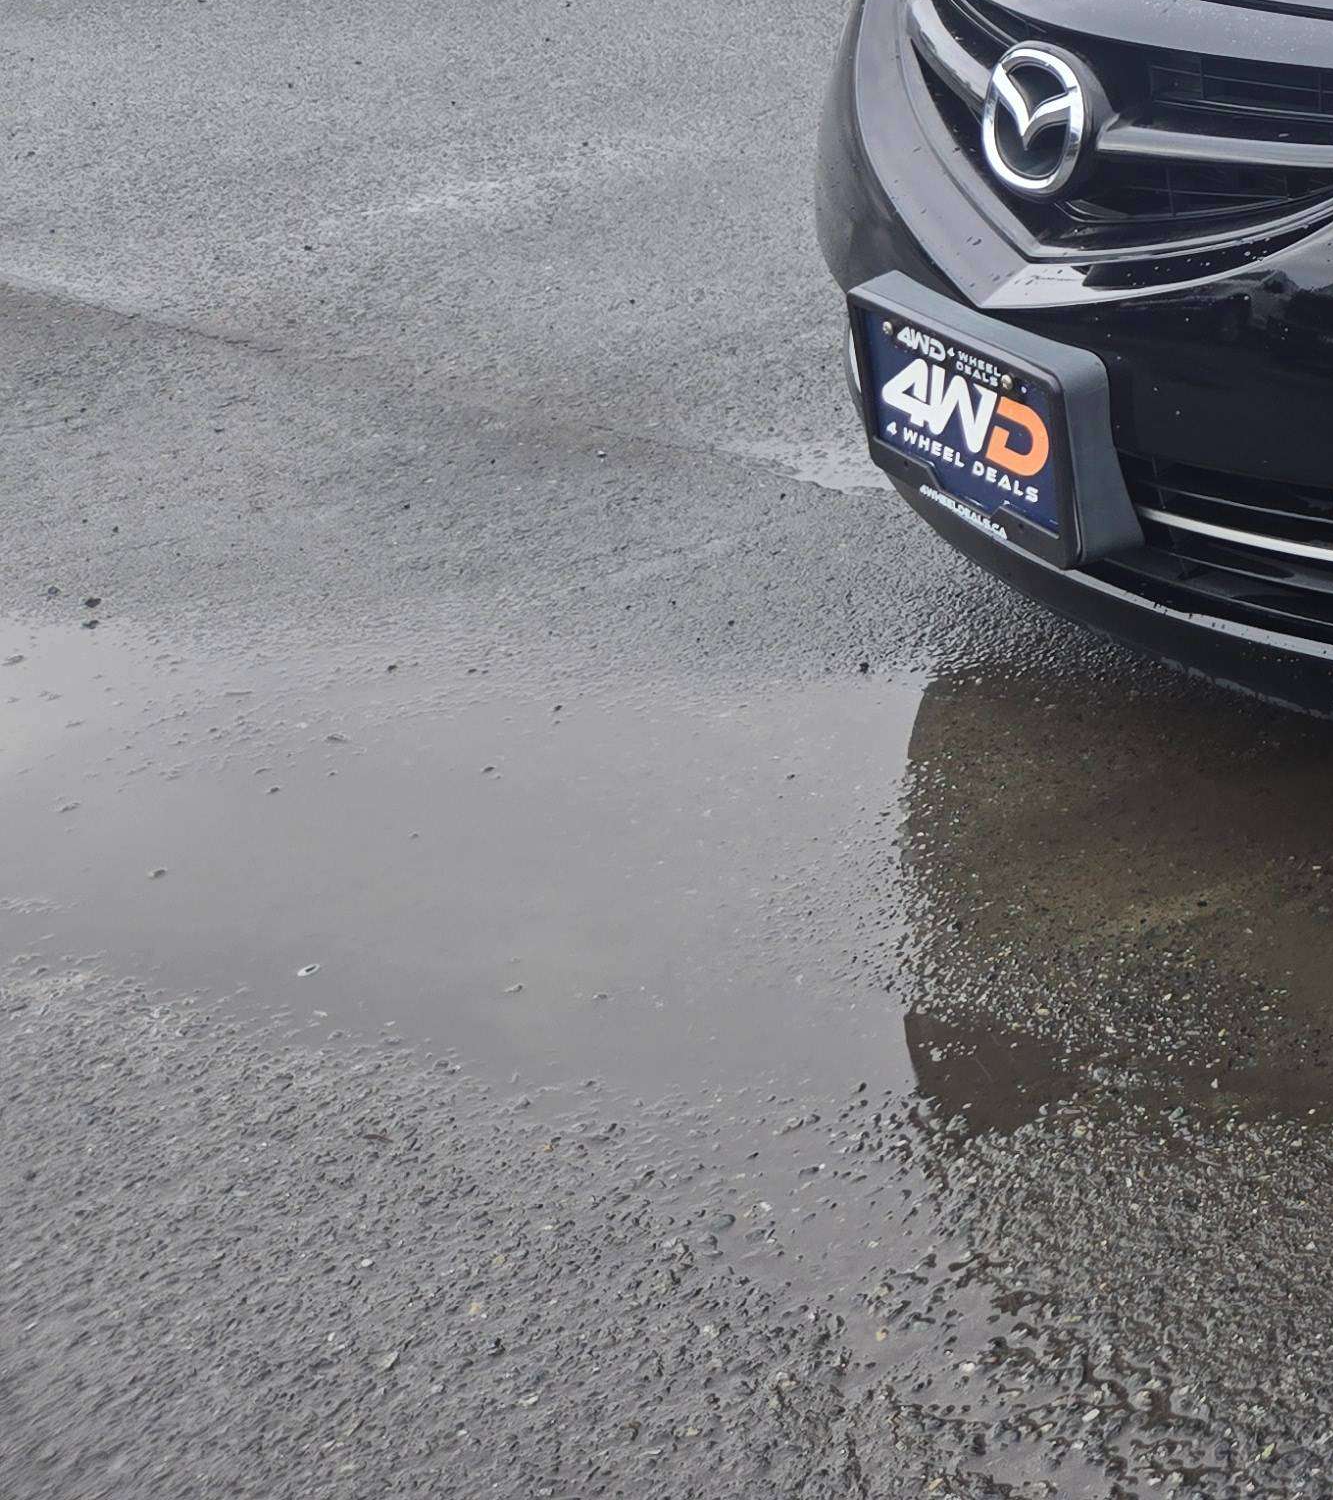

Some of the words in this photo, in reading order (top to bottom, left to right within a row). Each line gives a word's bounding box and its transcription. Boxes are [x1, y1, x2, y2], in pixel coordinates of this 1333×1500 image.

[896, 326, 946, 362] 4WD
[955, 361, 999, 387] DEALS
[957, 350, 1002, 377] WHEEL
[881, 358, 1050, 477] 4WD
[885, 421, 898, 437] 4
[903, 426, 965, 468] WHEEL
[972, 459, 1040, 503] DEALS
